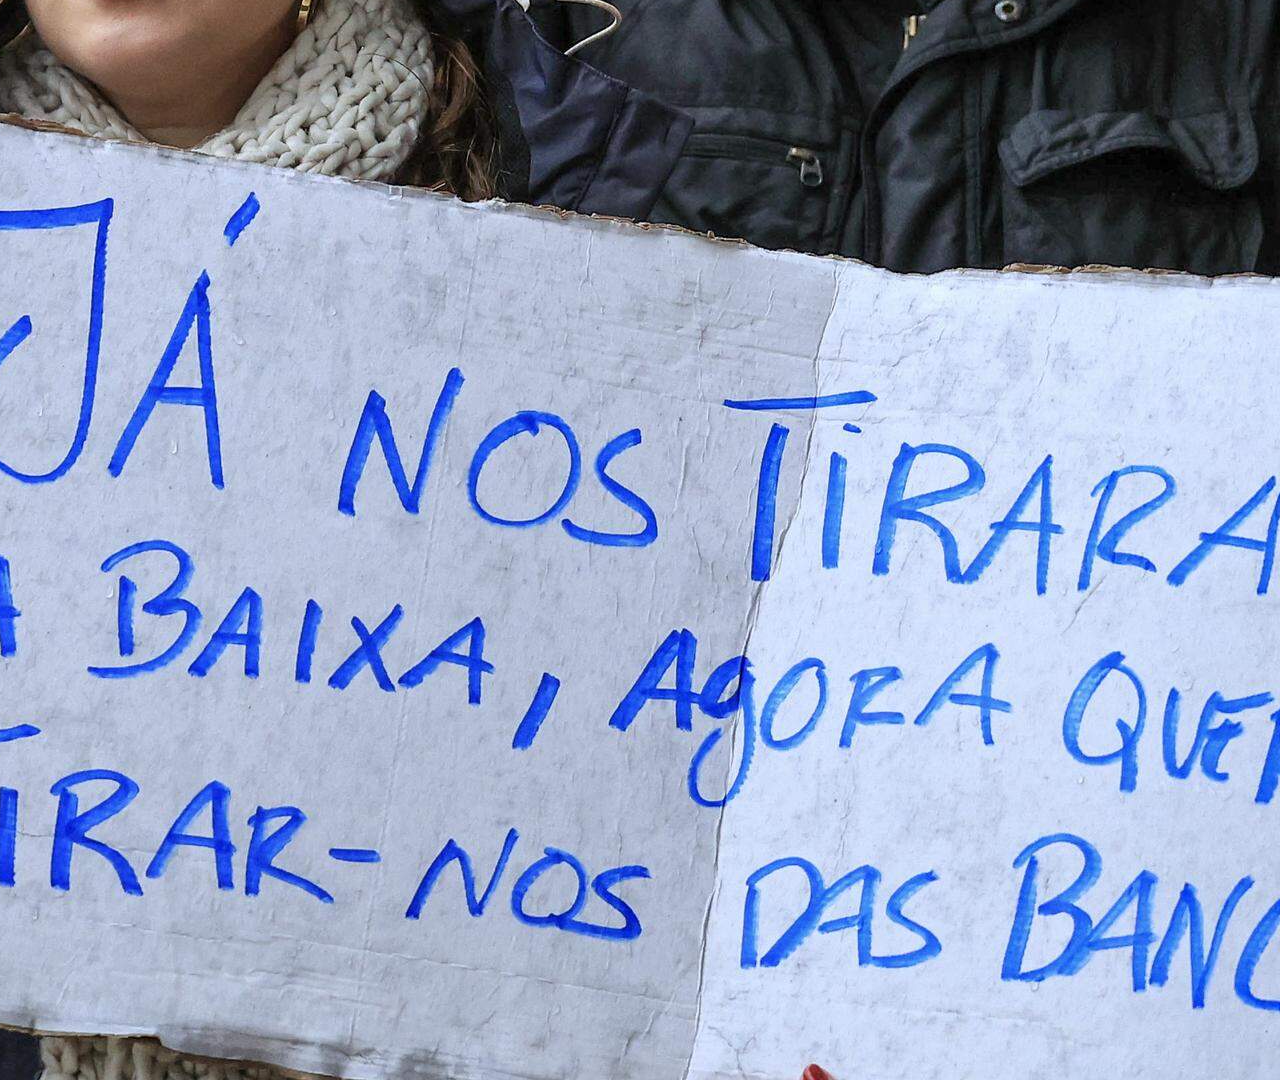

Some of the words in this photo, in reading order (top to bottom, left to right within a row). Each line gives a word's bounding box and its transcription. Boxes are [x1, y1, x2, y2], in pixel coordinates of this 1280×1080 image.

[337, 367, 661, 550] NOS
[87, 538, 562, 751] BAIXA,
[739, 855, 944, 971] DAS
